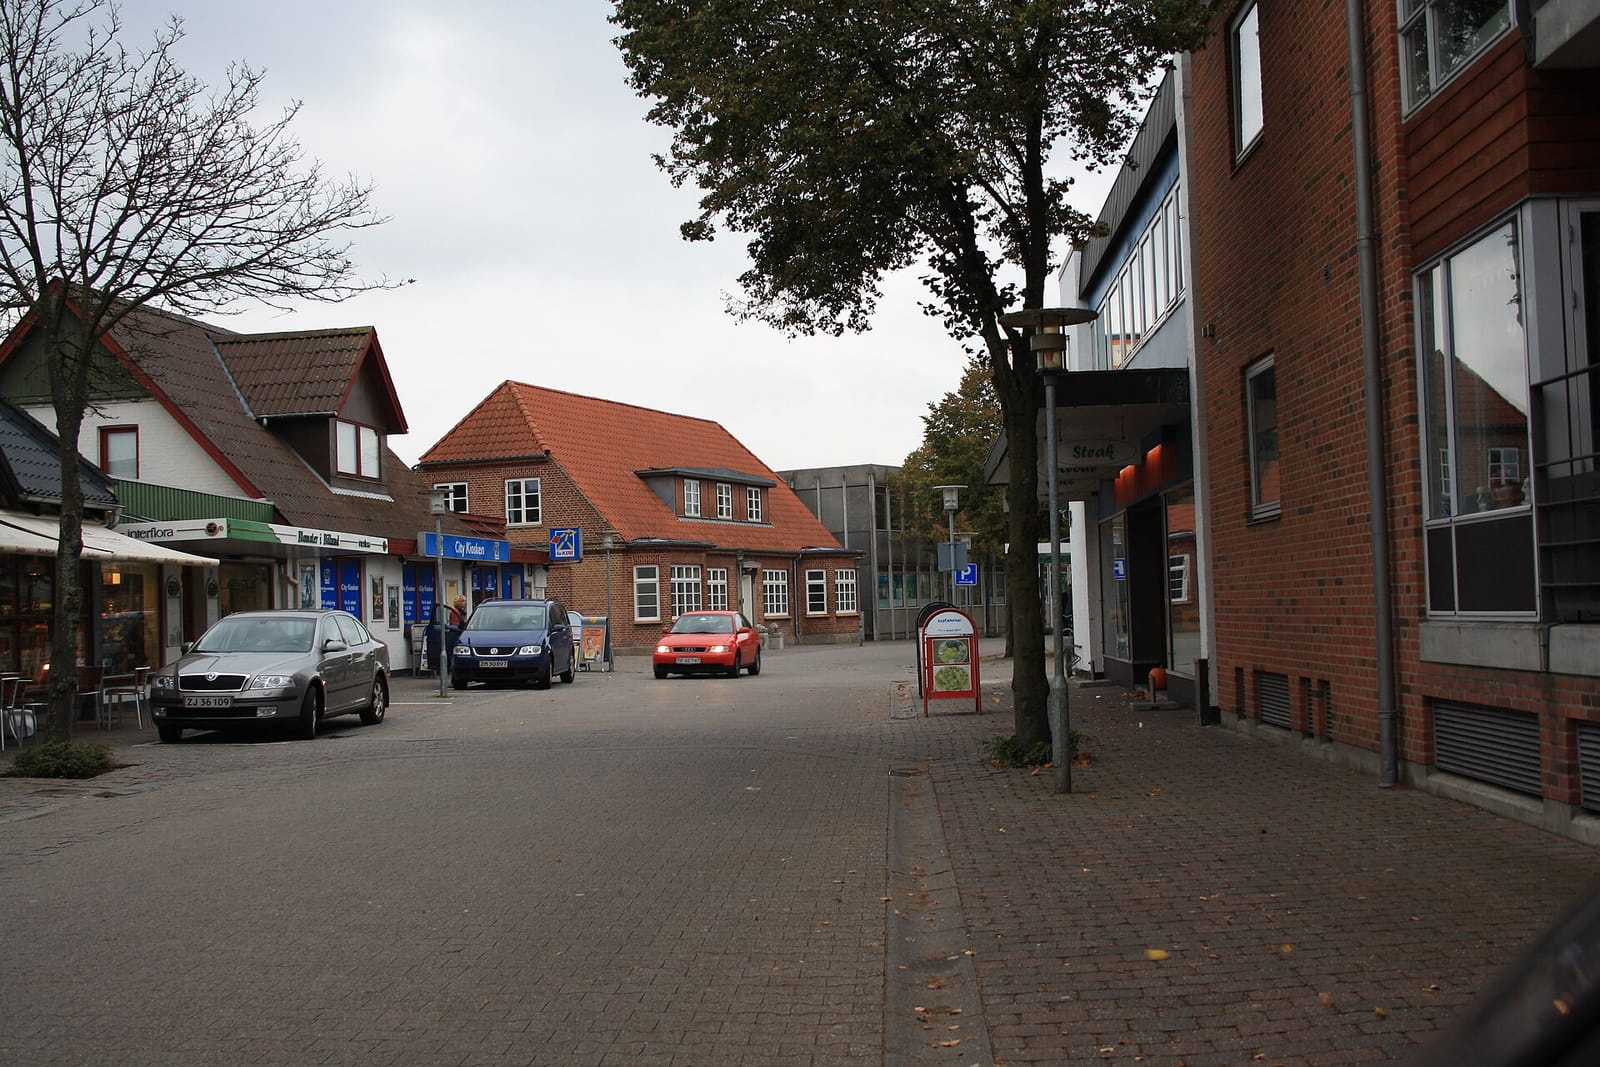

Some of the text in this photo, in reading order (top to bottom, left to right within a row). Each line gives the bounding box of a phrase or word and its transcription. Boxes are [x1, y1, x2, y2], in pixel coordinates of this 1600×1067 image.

[1072, 444, 1115, 460] Steak
[127, 527, 174, 538] interflora
[454, 540, 485, 557] City Kiosken
[961, 566, 972, 580] P
[186, 698, 230, 706] ZJ 36 109
